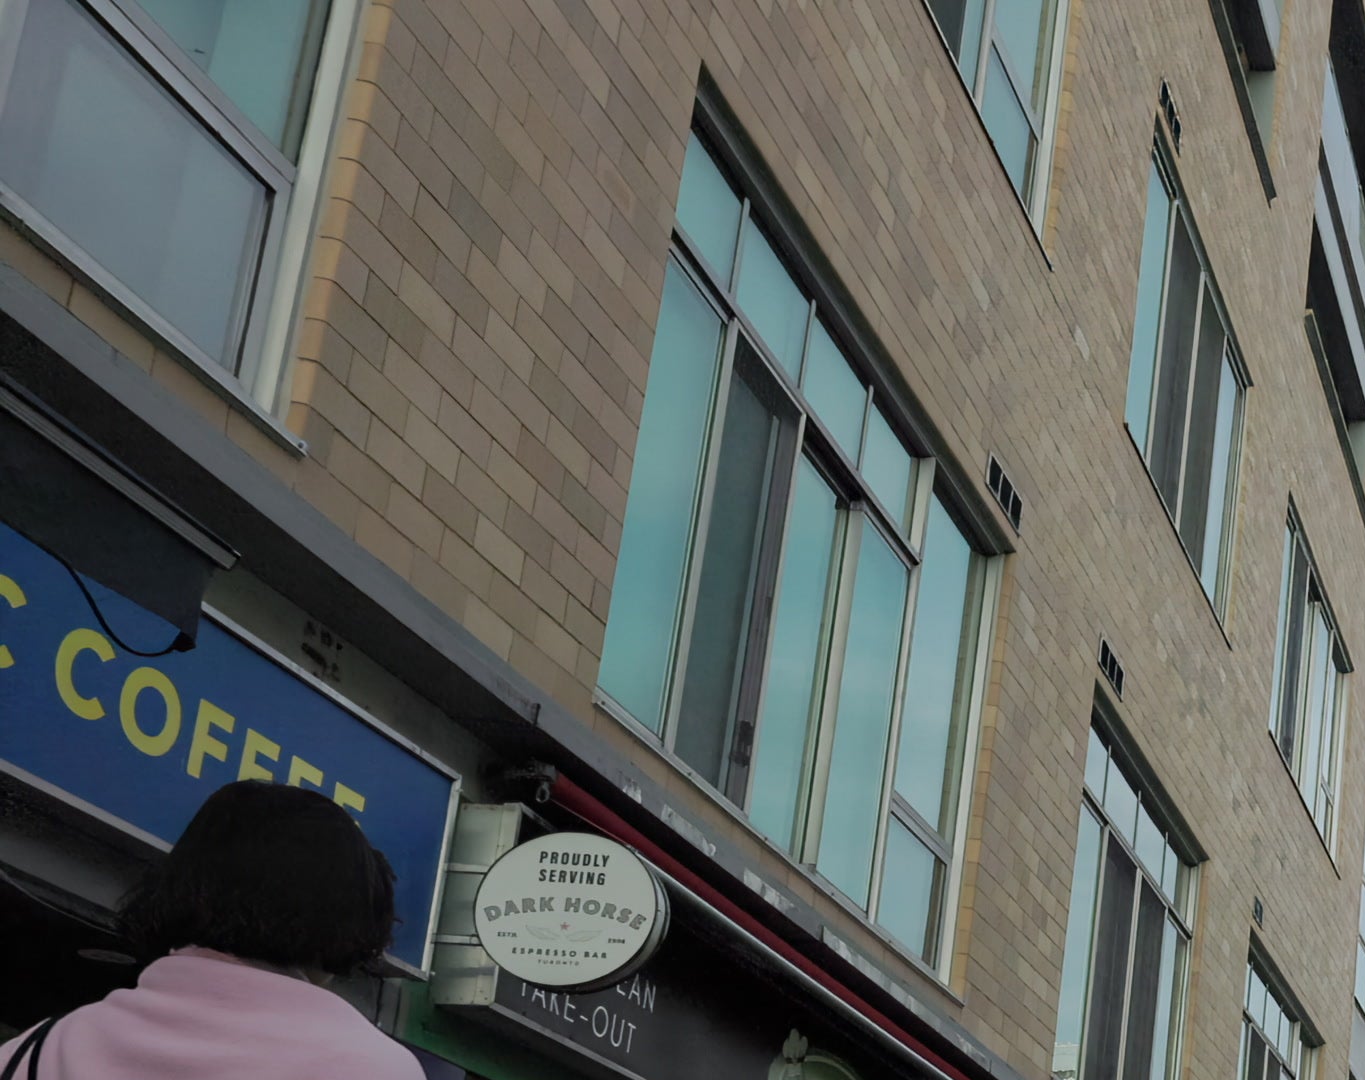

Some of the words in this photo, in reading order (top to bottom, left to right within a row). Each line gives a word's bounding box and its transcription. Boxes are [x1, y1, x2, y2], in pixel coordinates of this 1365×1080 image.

[539, 851, 610, 867] PROUDLY
[538, 868, 606, 885] SERVING
[484, 897, 555, 922] DARK
[564, 898, 647, 931] HORSE
[511, 947, 577, 957] ESPRESSO
[583, 951, 608, 959] BAR
